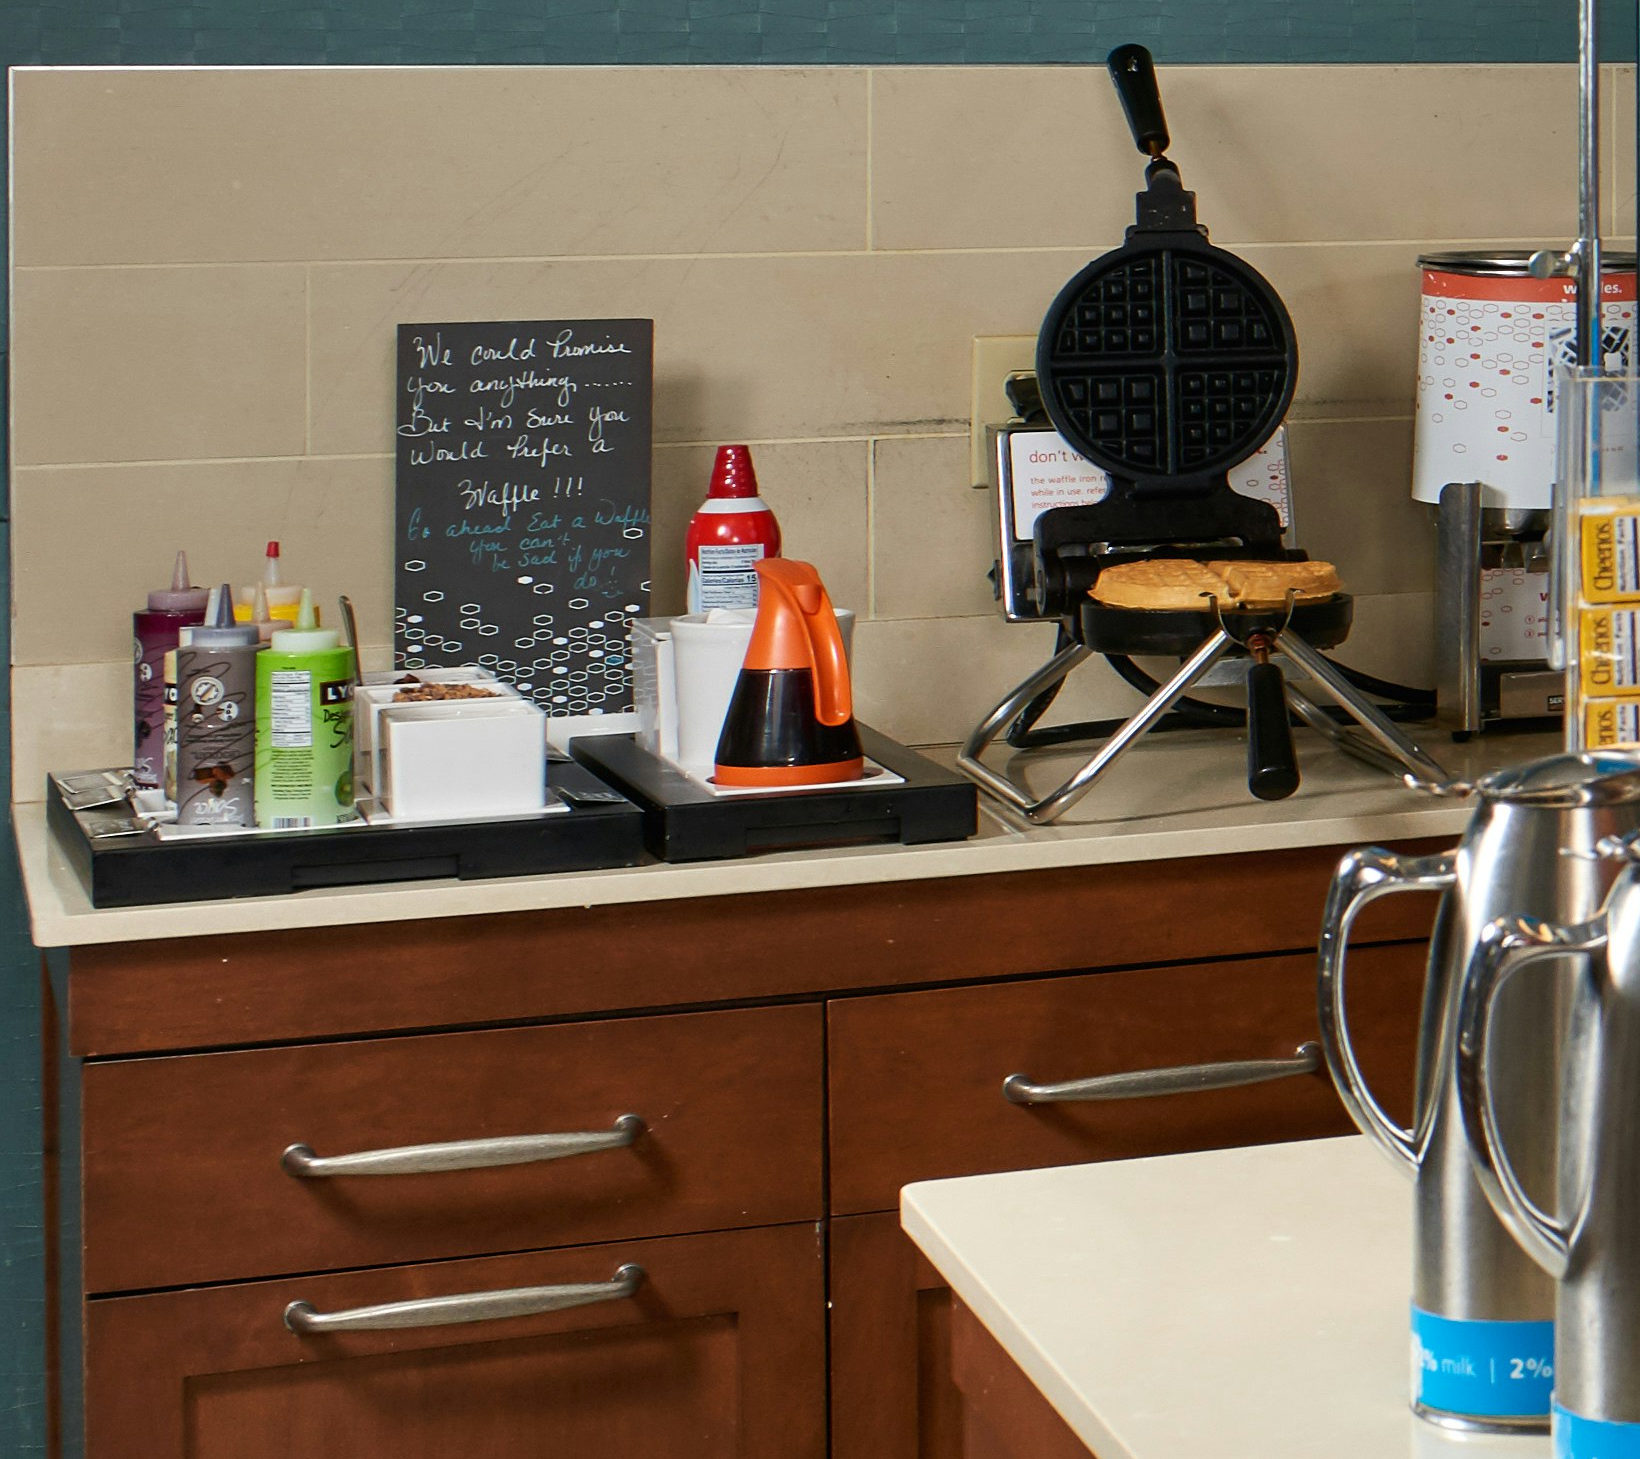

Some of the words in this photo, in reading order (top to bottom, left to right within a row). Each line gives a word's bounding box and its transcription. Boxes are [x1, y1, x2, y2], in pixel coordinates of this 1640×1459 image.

[1029, 450, 1069, 463] don't
[1031, 476, 1045, 485] the
[1048, 475, 1077, 484] waffle
[1079, 475, 1097, 483] iron
[1509, 1357, 1553, 1379] 2%
